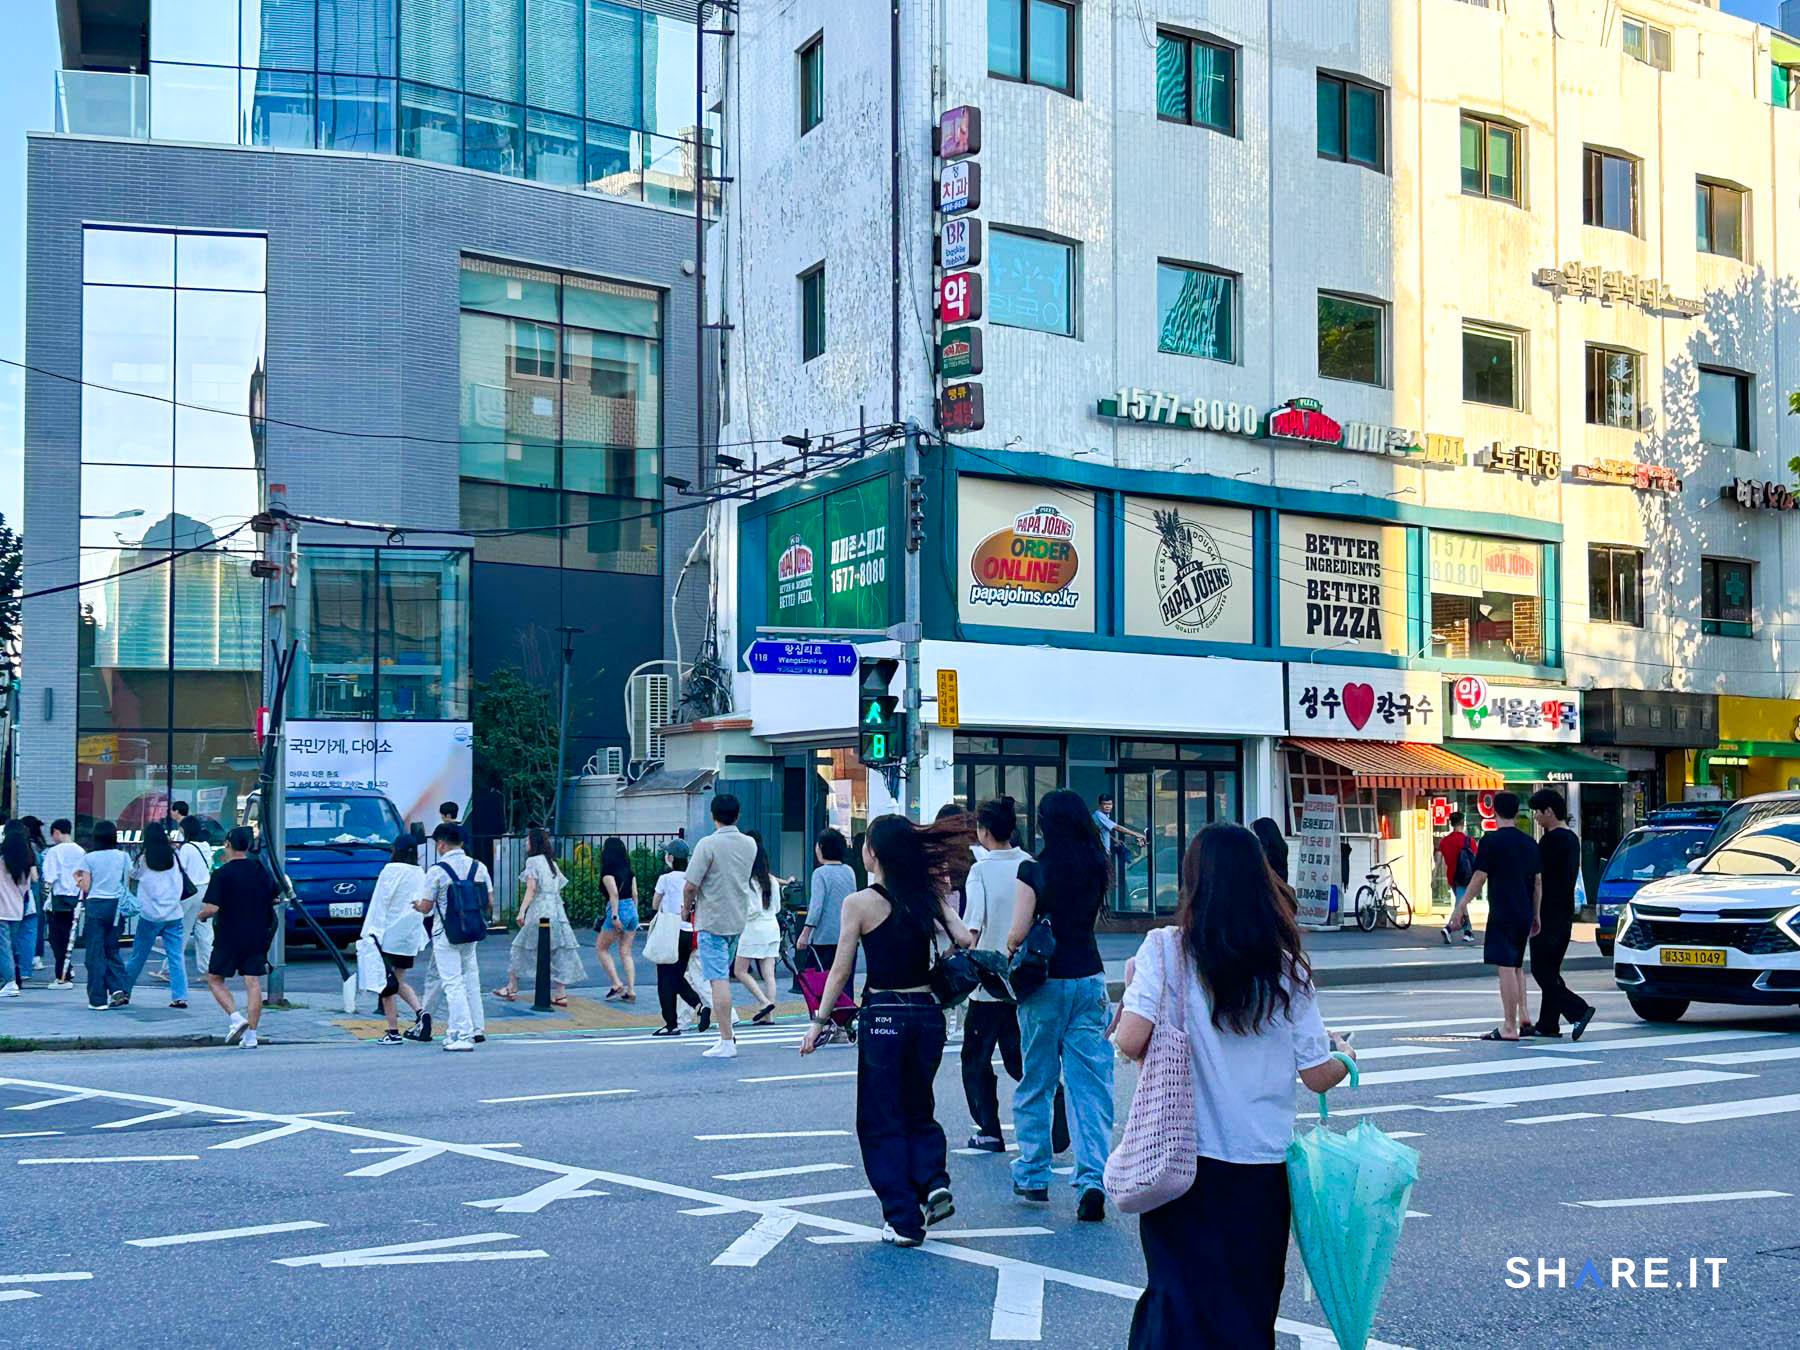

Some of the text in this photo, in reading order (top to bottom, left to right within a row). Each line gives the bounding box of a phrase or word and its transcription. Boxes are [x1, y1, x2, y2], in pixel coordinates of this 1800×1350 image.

[943, 177, 968, 200] 치과
[946, 221, 966, 245] BR
[944, 276, 968, 317] 약
[1114, 387, 1258, 436] 1577-8080
[1490, 442, 1561, 480] 노래방
[1016, 516, 1042, 533] PAPA
[831, 527, 886, 565] 파파존스피자
[1011, 539, 1070, 561] ORDER
[1305, 532, 1380, 561] BETTER
[1431, 533, 1480, 560] 1577
[831, 558, 886, 594] 1577-8080
[983, 556, 1059, 584] ONLINE
[1305, 556, 1381, 578] INGREDIENTS
[1485, 553, 1506, 575] PAPA
[971, 584, 1079, 607] papajohns.co.kr
[1161, 581, 1194, 622] PAPA
[1306, 579, 1381, 606] BETTER
[1175, 624, 1200, 634] QUALITY
[1306, 603, 1382, 640] PIZZA
[754, 653, 768, 662] 118
[784, 644, 823, 656] 왕십리로
[838, 655, 851, 664] 114
[1299, 686, 1434, 726] 성수 칼국수
[1459, 679, 1482, 708] 약
[1491, 697, 1578, 731] 서울숲약국
[289, 738, 393, 755] 국민가게, 다이소
[873, 734, 885, 759] 8
[1694, 951, 1721, 964] 1049
